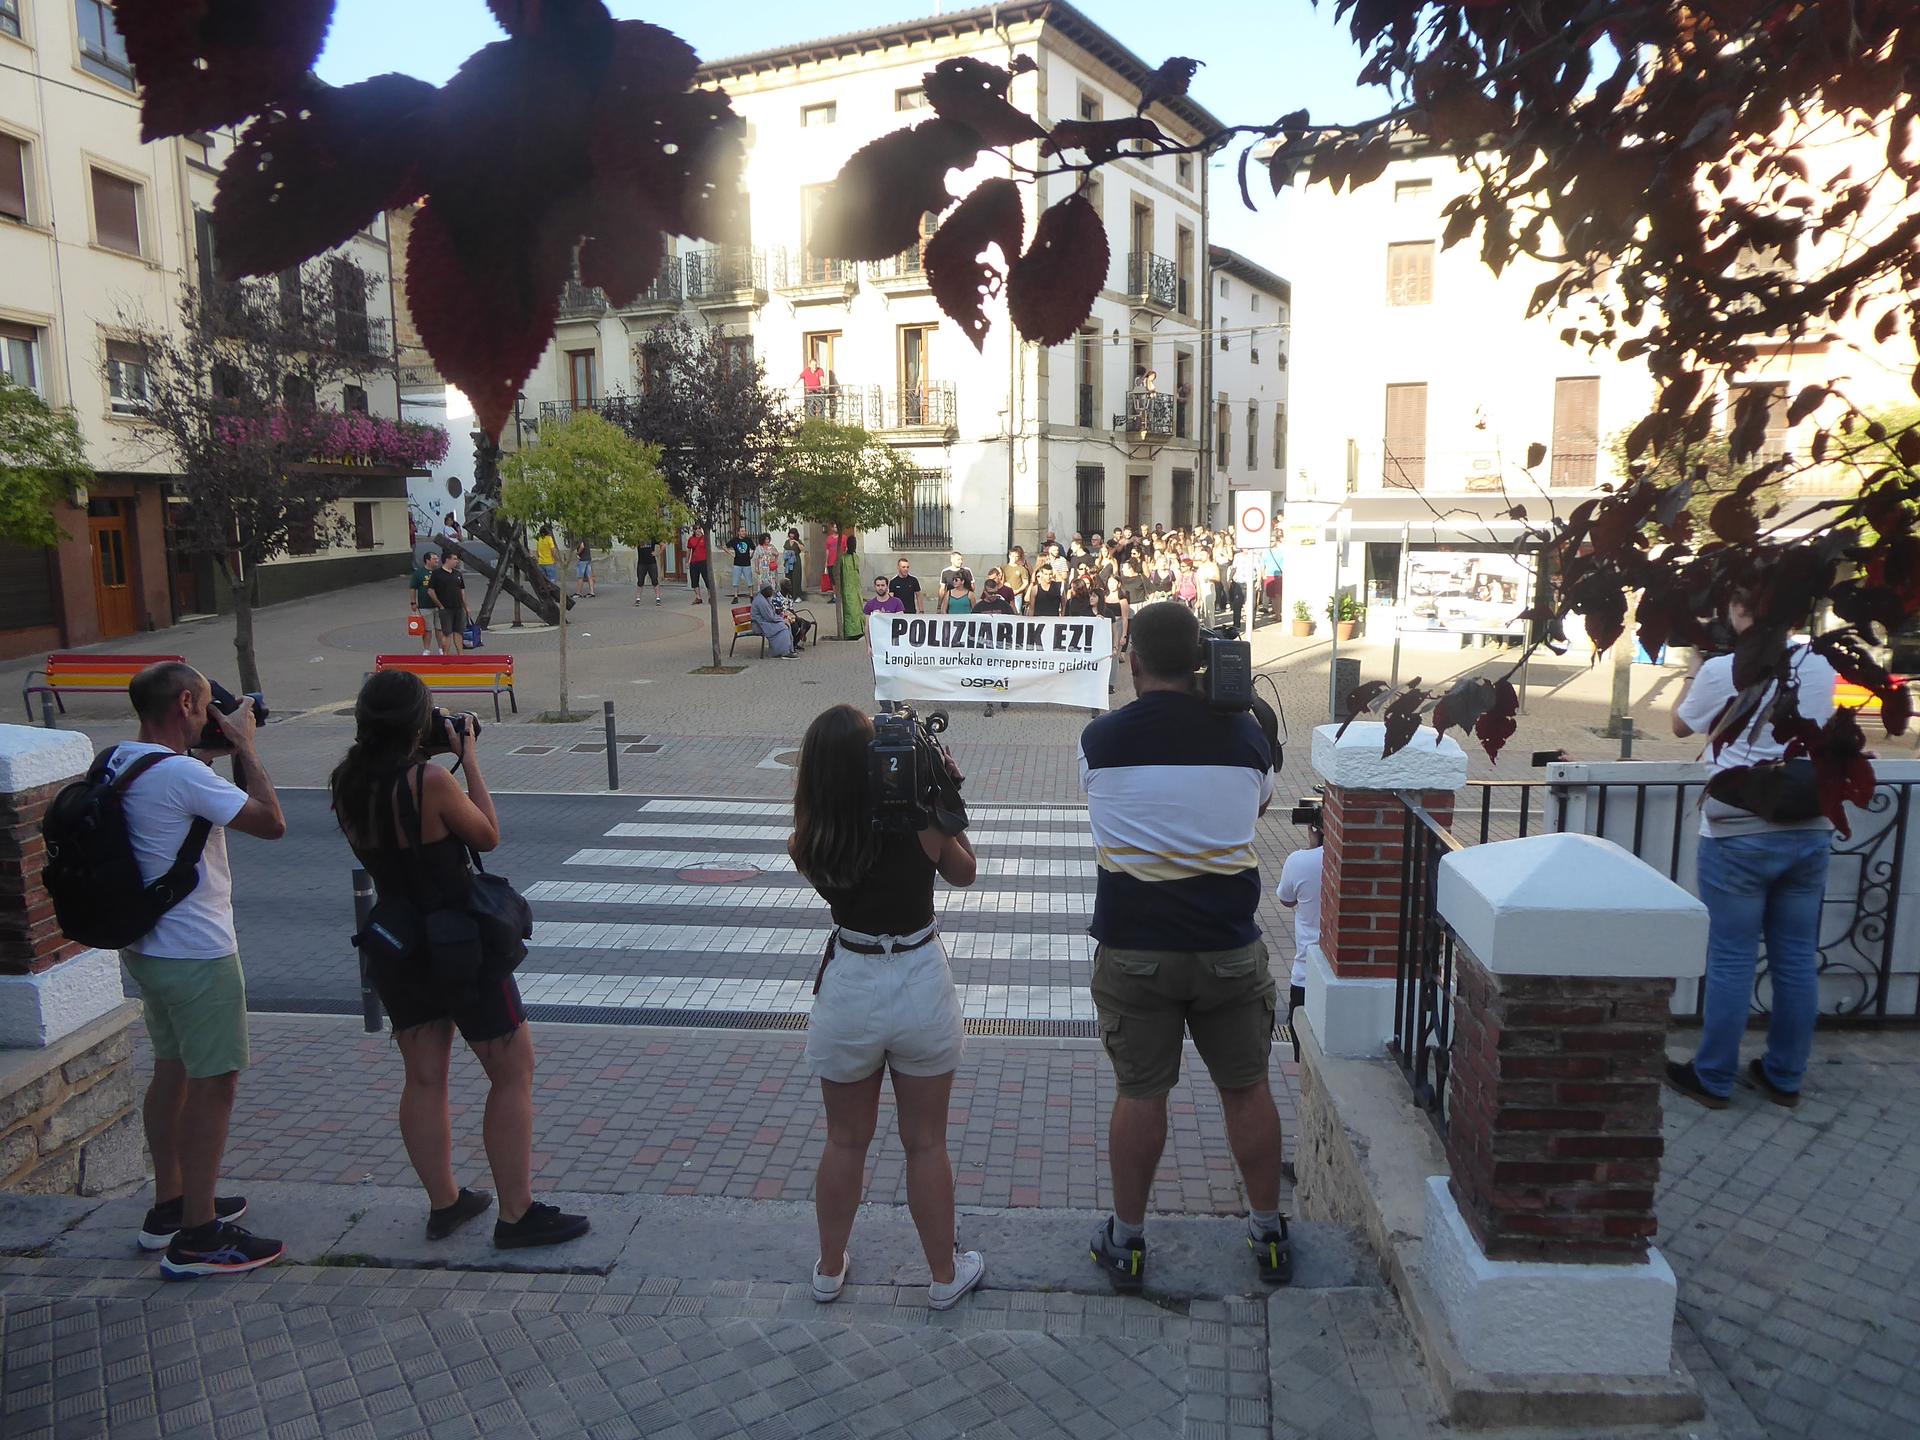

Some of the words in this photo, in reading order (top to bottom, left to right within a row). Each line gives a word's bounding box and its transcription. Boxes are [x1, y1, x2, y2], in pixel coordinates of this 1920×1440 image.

[891, 618, 1046, 652] POLIZIARIK
[1053, 623, 1094, 653] EZ!
[885, 651, 936, 667] Langileon
[939, 652, 983, 666] aurkako
[987, 658, 1055, 671] errepresioa
[890, 757, 898, 771] 2
